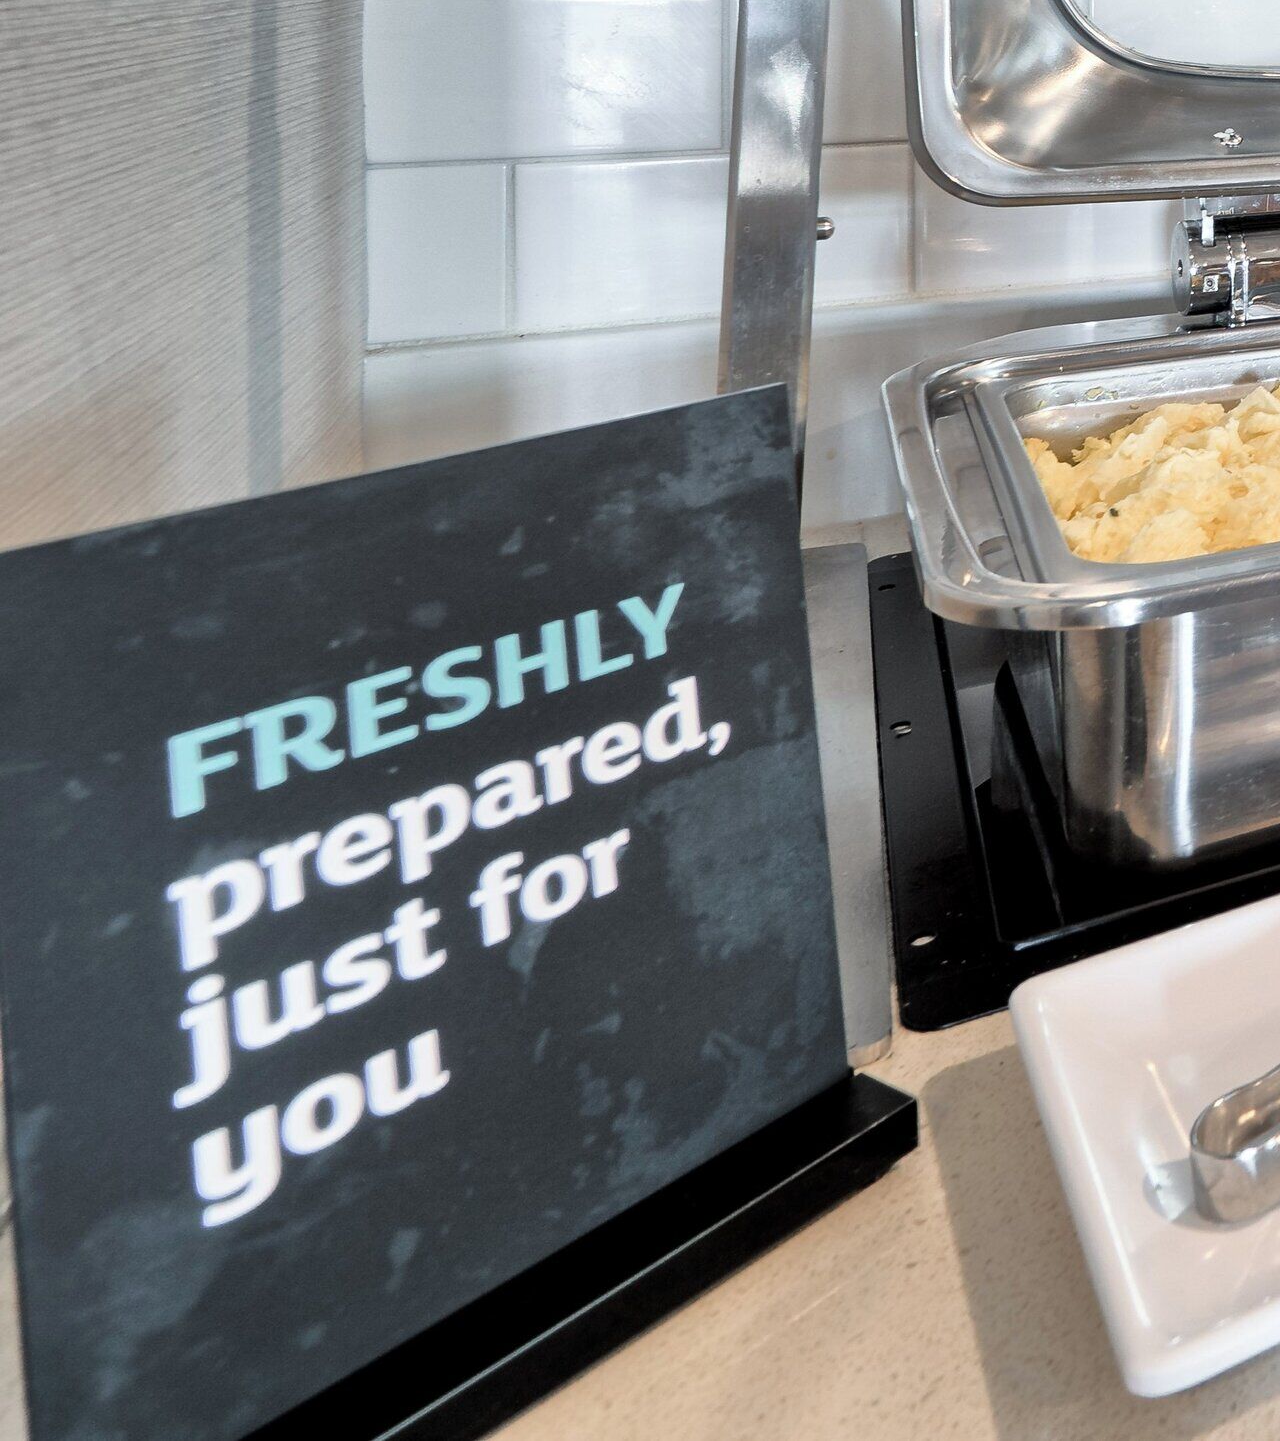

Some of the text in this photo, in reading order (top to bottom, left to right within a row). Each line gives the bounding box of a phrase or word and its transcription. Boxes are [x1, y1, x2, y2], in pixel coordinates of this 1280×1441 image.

[165, 582, 686, 821] FRESHLY
[166, 675, 733, 973] prepared,
[172, 828, 632, 1111] just for
[190, 1027, 451, 1229] you
